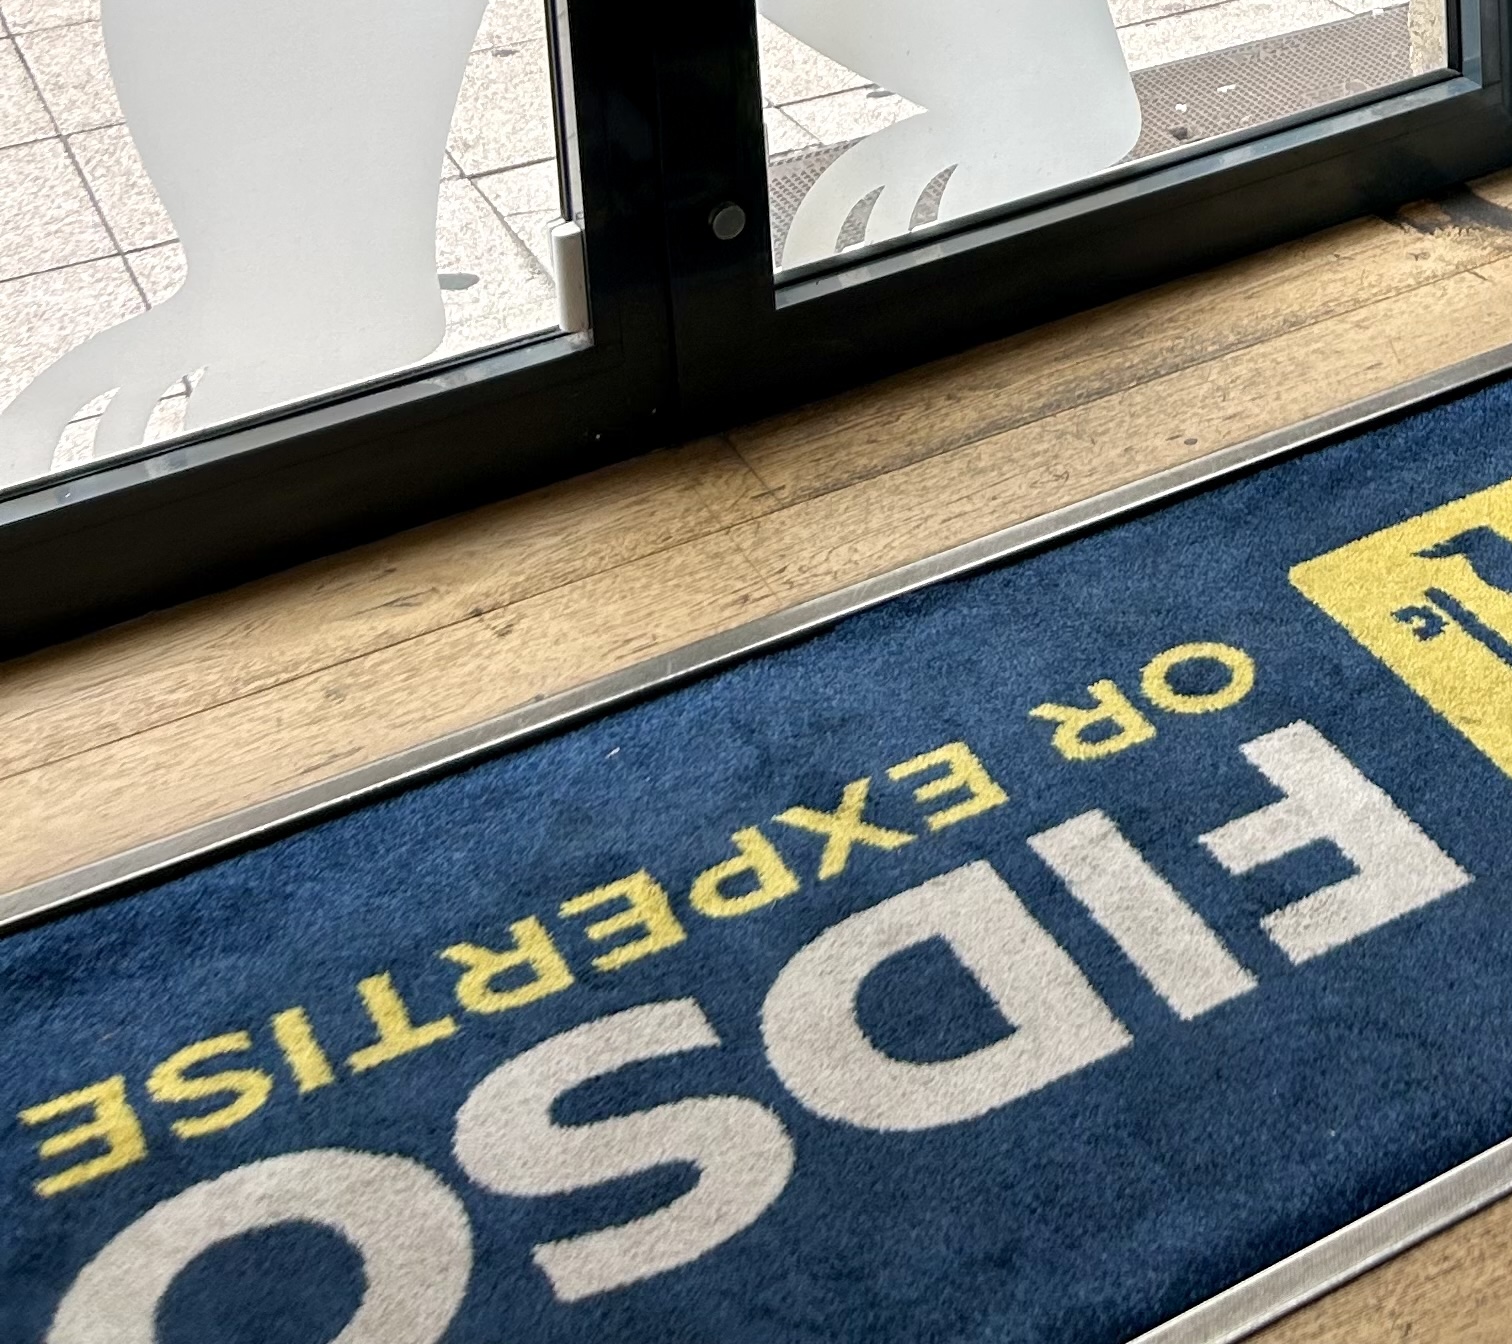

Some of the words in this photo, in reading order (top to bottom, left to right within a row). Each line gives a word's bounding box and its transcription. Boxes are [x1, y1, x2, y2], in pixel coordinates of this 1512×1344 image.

[1029, 641, 1256, 761] OR
[18, 741, 1009, 1199] EXPERTISE
[46, 718, 1476, 1344] FIDSO
